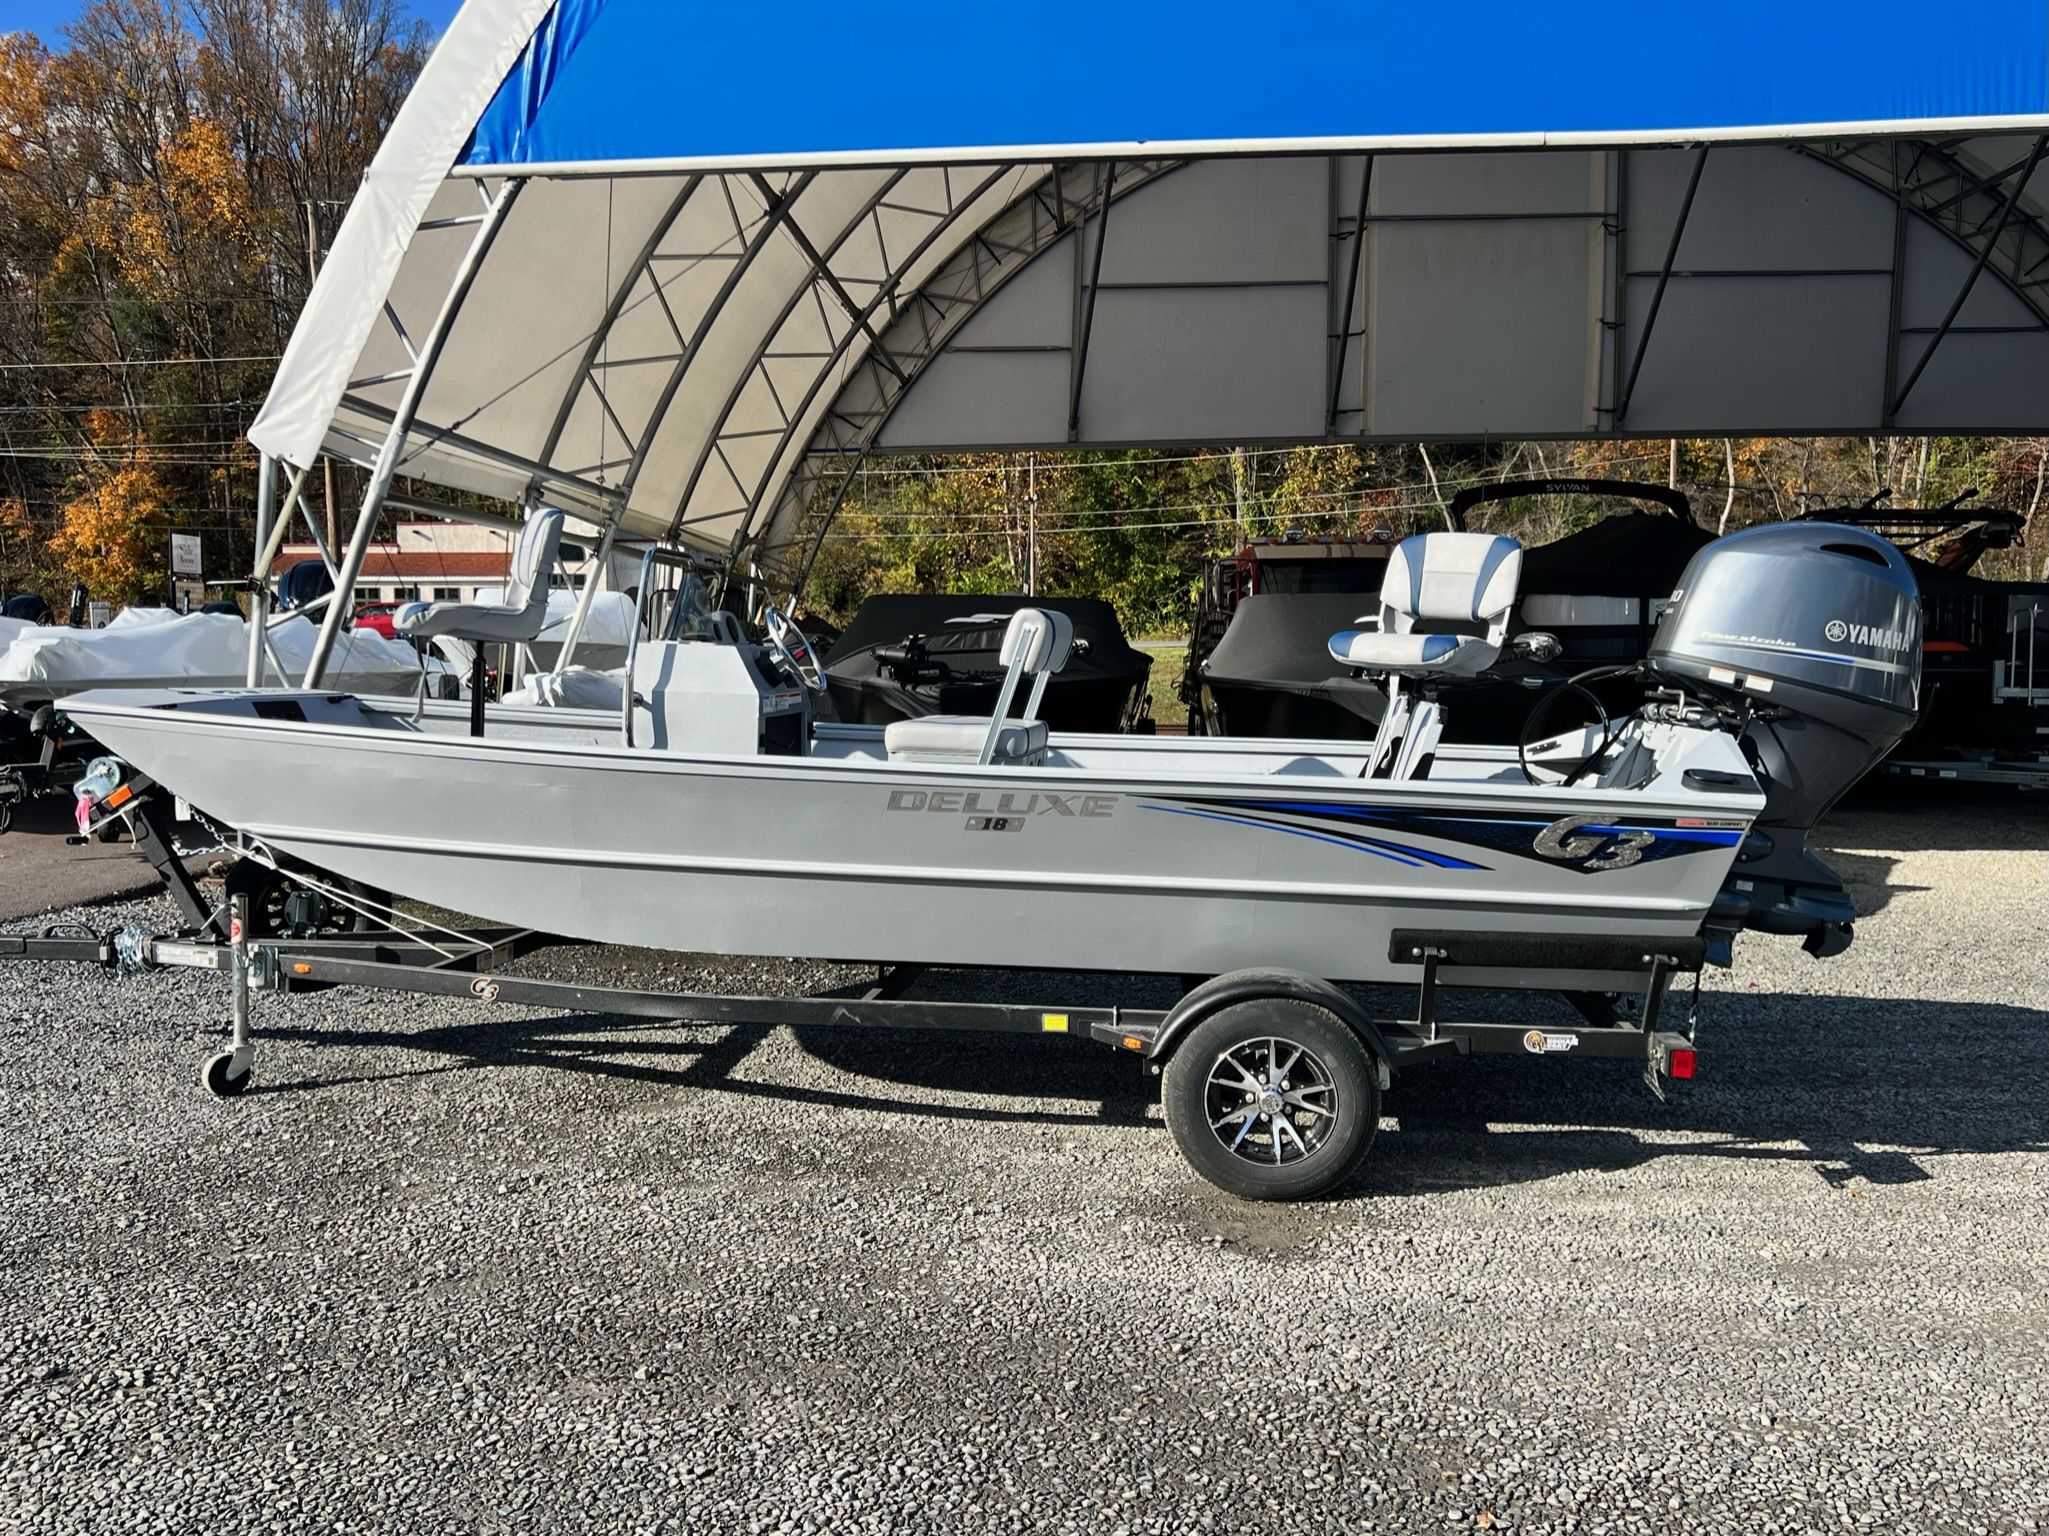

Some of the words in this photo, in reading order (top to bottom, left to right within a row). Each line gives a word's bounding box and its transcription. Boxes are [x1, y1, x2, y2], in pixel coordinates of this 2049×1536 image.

[1546, 484, 1590, 492] SYLVAN
[1849, 623, 1909, 652] YAMAHA
[887, 790, 1118, 818] DELUXE
[981, 817, 1009, 831] 18
[1533, 814, 1656, 869] G3
[471, 976, 500, 1000] G3
